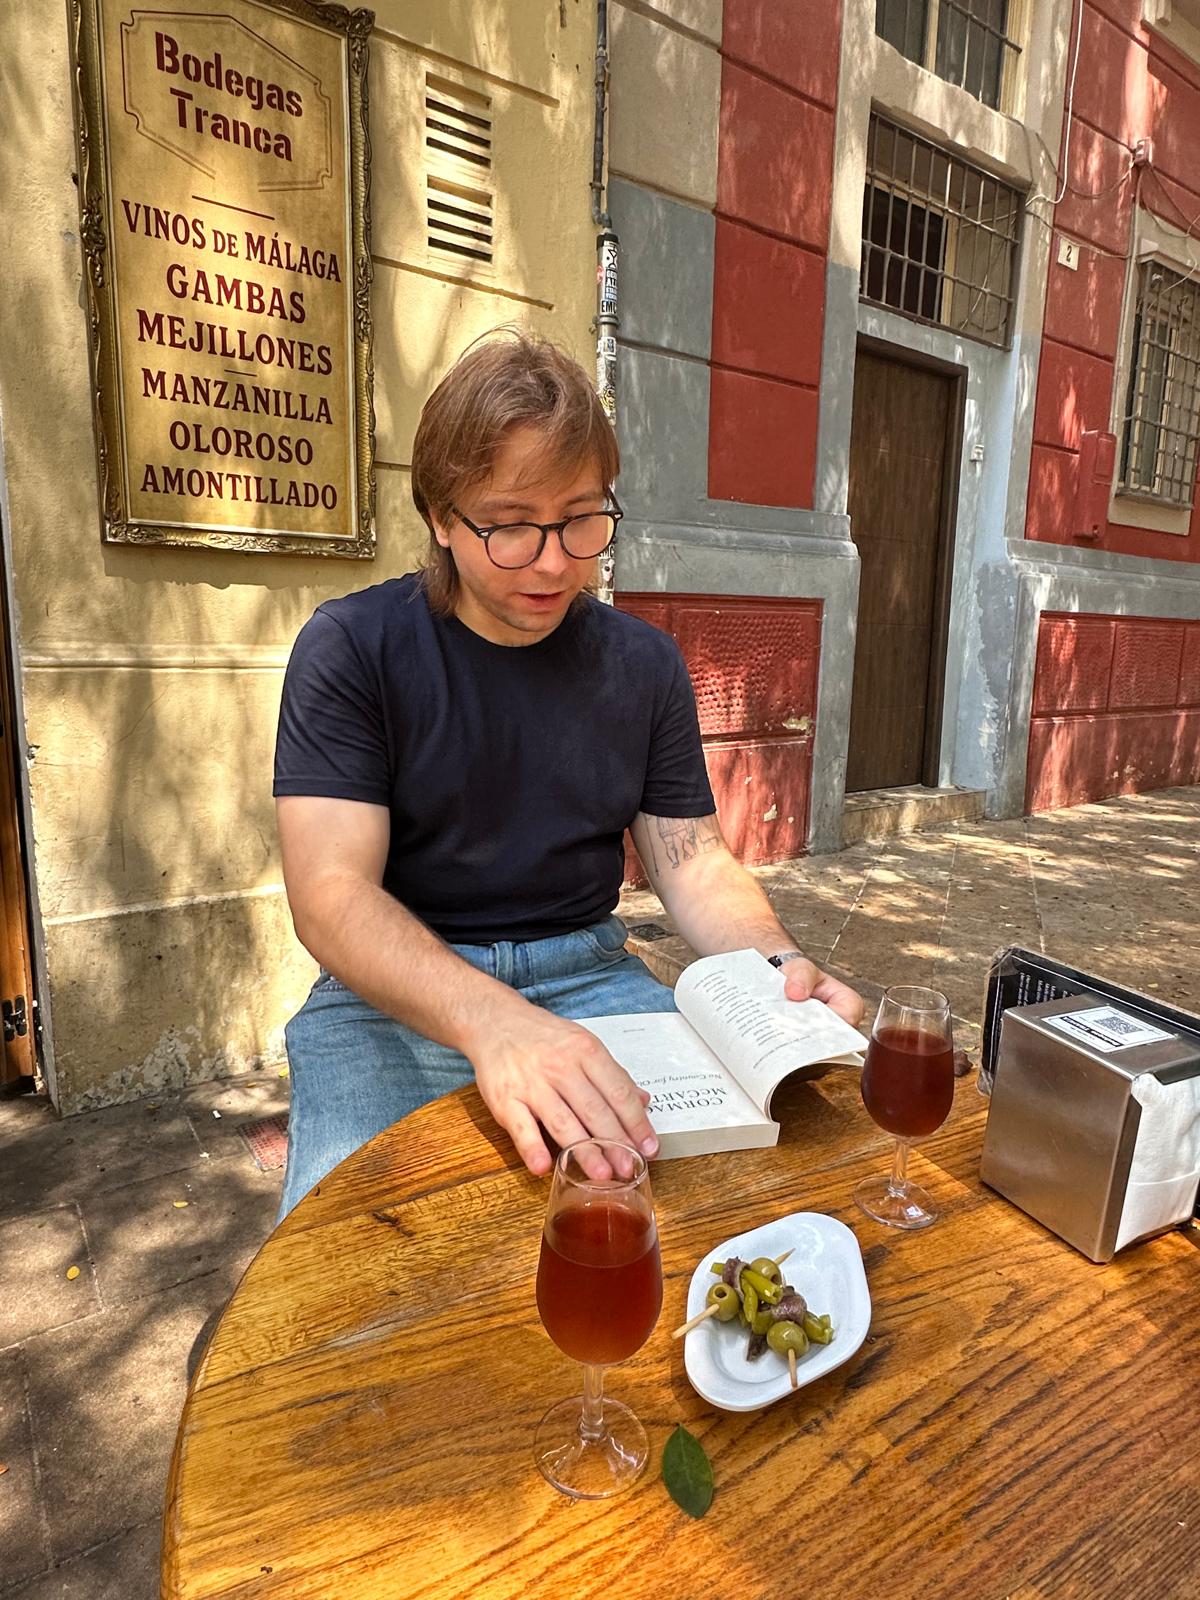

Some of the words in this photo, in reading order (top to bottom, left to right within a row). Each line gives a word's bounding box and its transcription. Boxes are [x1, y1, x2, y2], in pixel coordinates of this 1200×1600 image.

[155, 32, 303, 117] Bodegas
[170, 88, 292, 161] Tranca
[121, 200, 206, 250] VINOS
[213, 229, 238, 258] DE
[245, 231, 342, 283] MÁLAGA
[1066, 245, 1073, 262] 2
[167, 264, 306, 324] GAMBAS
[137, 309, 332, 375] MEJILLONES
[142, 368, 333, 424] MANZANILLA
[170, 421, 313, 465] OLOROSO
[140, 464, 338, 510] AMONTILLADO
[652, 1087, 727, 1103] McCART
